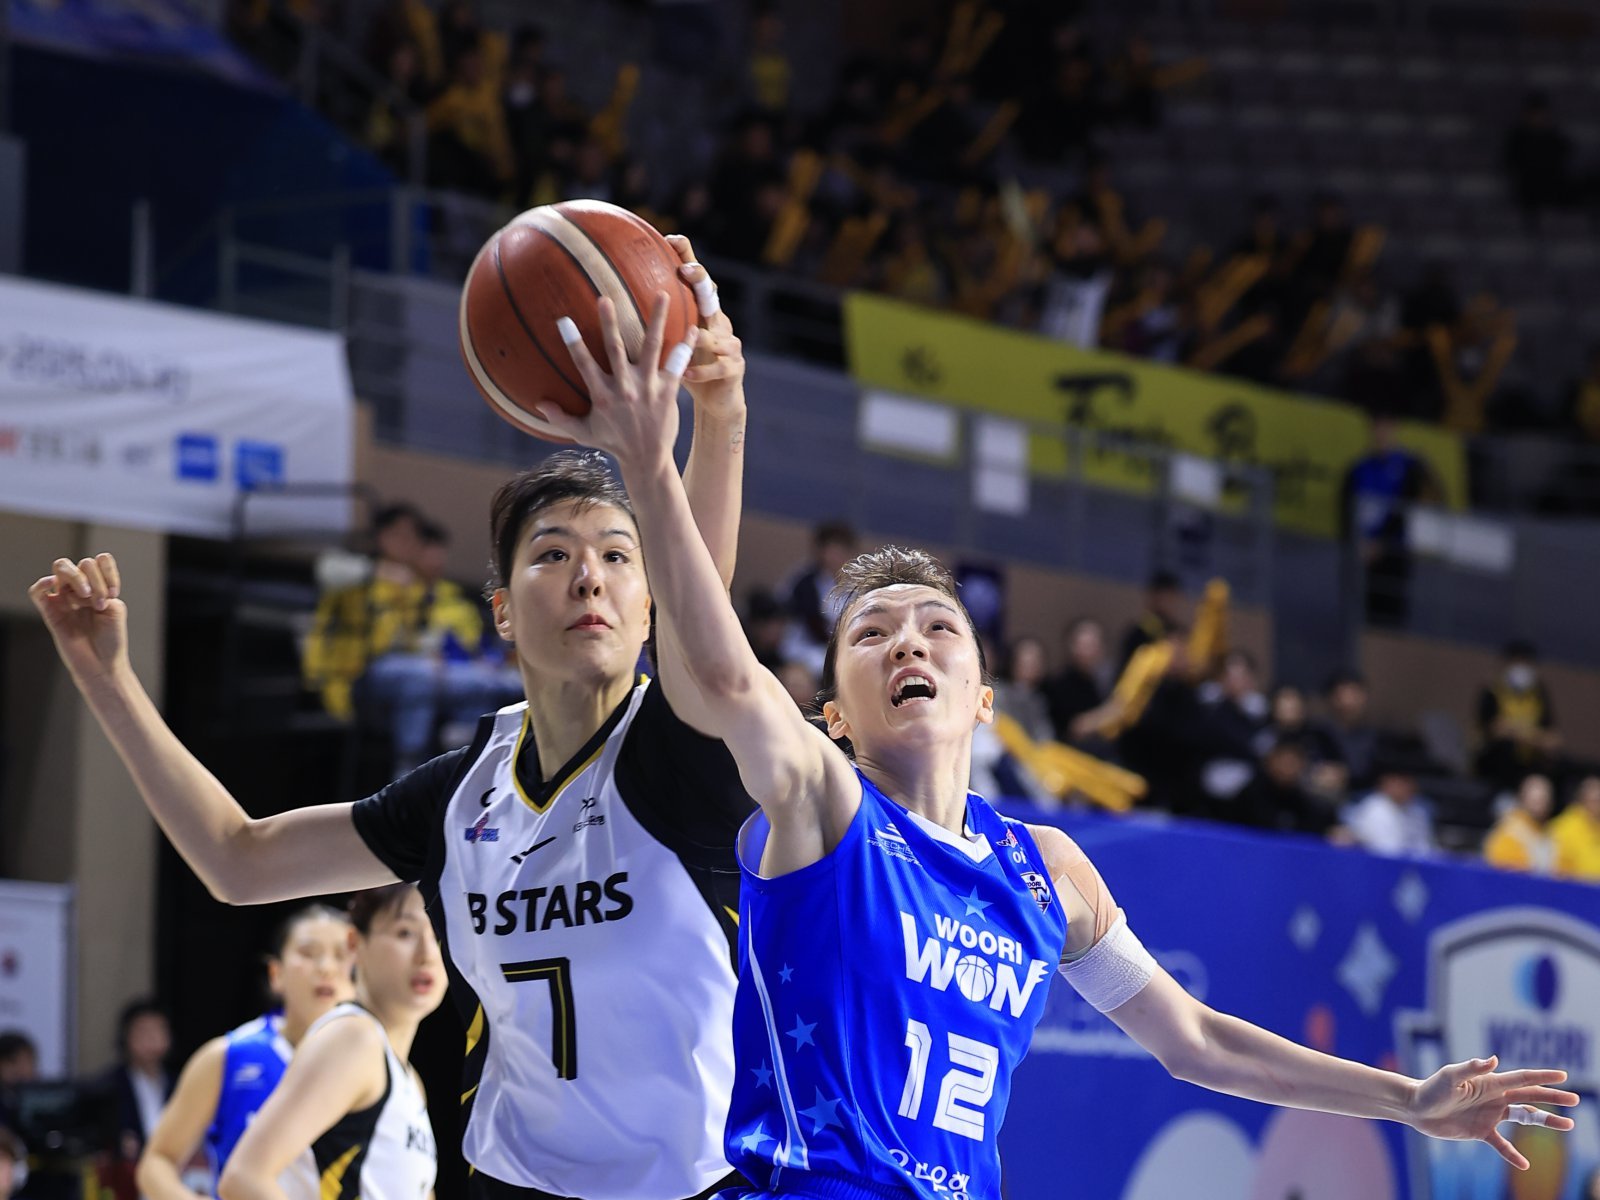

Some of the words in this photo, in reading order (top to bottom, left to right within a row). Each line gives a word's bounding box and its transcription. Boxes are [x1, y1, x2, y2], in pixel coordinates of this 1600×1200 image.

[465, 892, 487, 935] B
[494, 871, 633, 936] STARS
[934, 913, 1023, 967] WOORI
[500, 957, 577, 1080] 7
[899, 910, 1050, 1019] WON
[898, 1017, 999, 1142] 12
